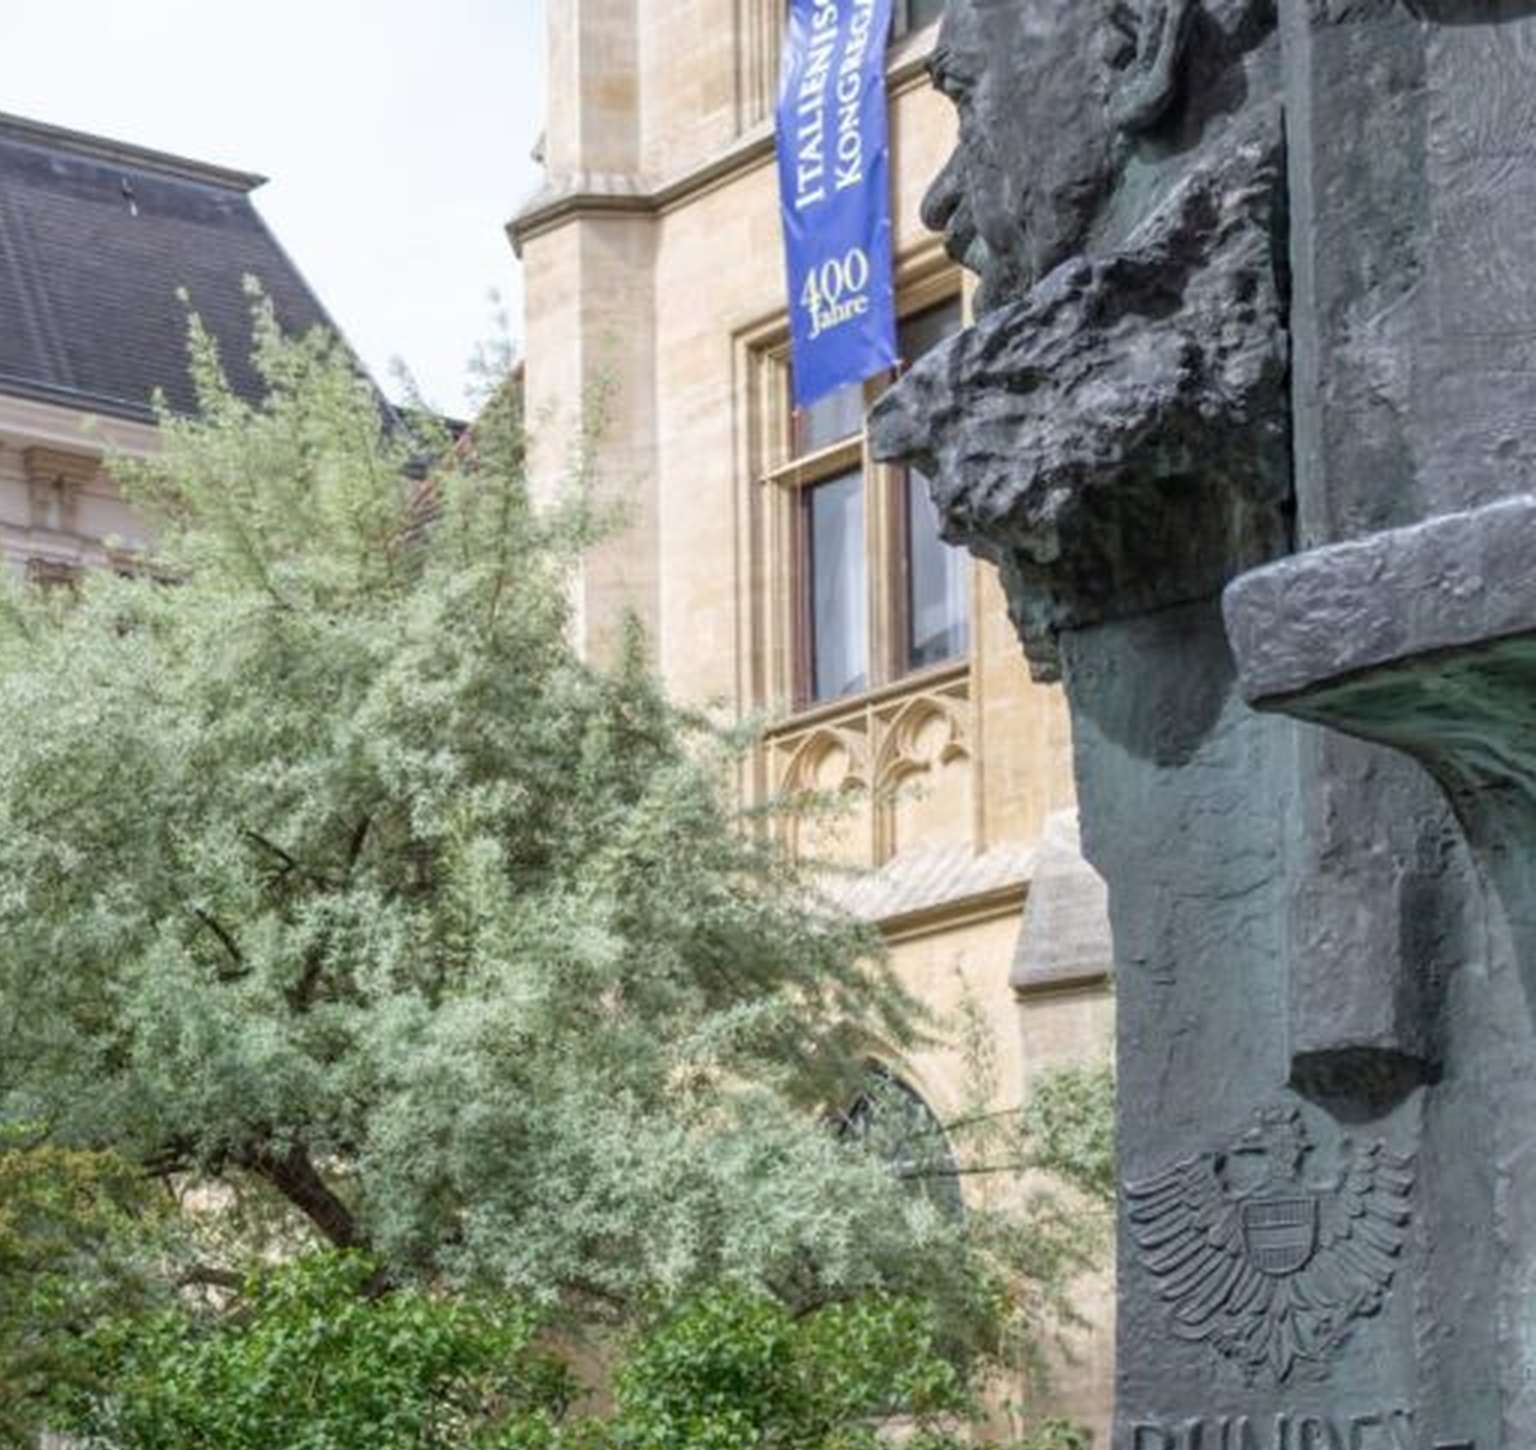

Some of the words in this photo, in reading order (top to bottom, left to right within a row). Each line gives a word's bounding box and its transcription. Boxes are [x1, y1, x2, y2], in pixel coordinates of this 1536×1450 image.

[795, 0, 838, 209] ITALIENIS
[800, 247, 869, 308] 400
[808, 294, 870, 340] Jahre
